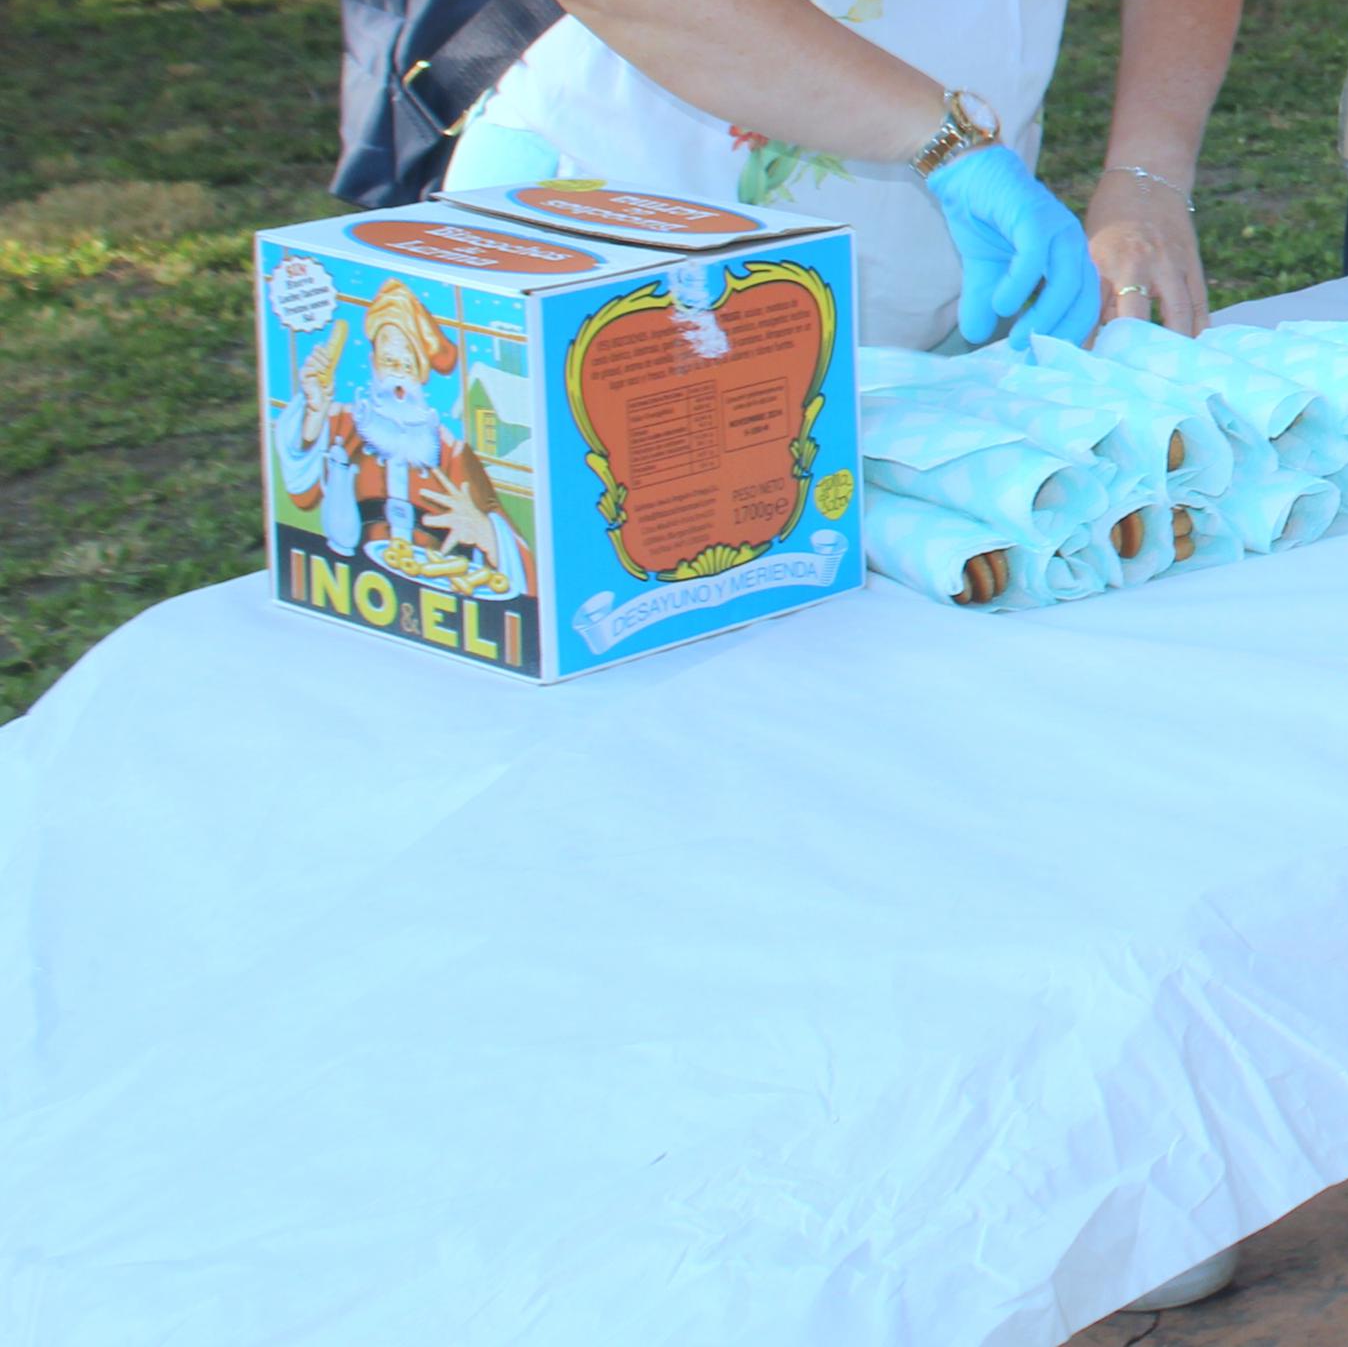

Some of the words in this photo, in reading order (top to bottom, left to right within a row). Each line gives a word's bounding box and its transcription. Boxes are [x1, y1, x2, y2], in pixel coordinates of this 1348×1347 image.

[385, 240, 500, 267] Lerma
[424, 225, 575, 262] Bizcochos
[612, 586, 714, 637] DESAYUNO
[714, 582, 725, 599] Y
[727, 562, 819, 594] MERIENDA
